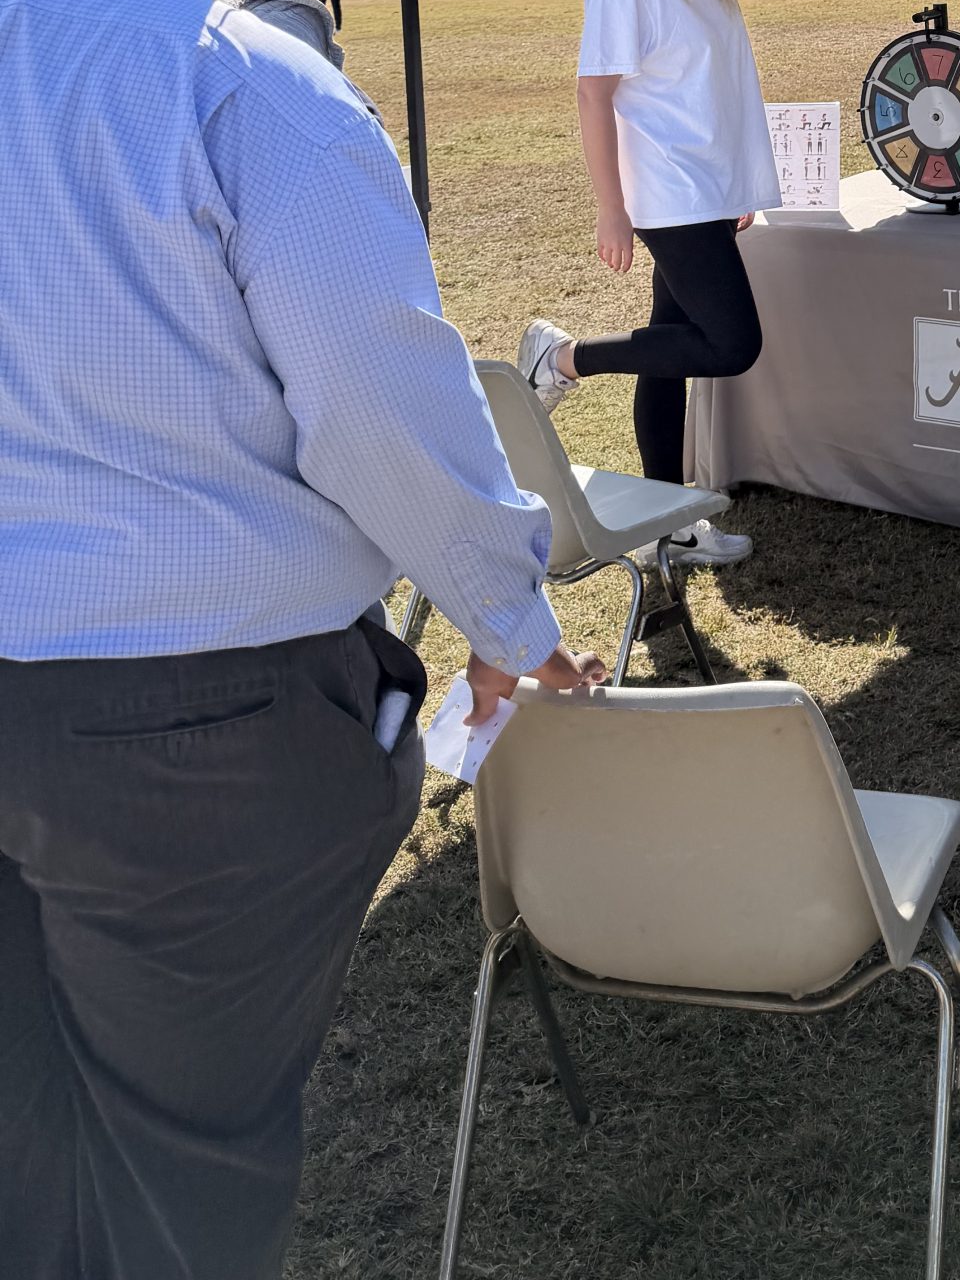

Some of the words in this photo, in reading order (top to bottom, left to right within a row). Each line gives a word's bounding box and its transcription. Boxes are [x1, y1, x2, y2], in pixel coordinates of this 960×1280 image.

[932, 54, 944, 76] 7
[898, 67, 916, 86] 6
[879, 105, 897, 118] 5
[933, 161, 945, 178] 3
